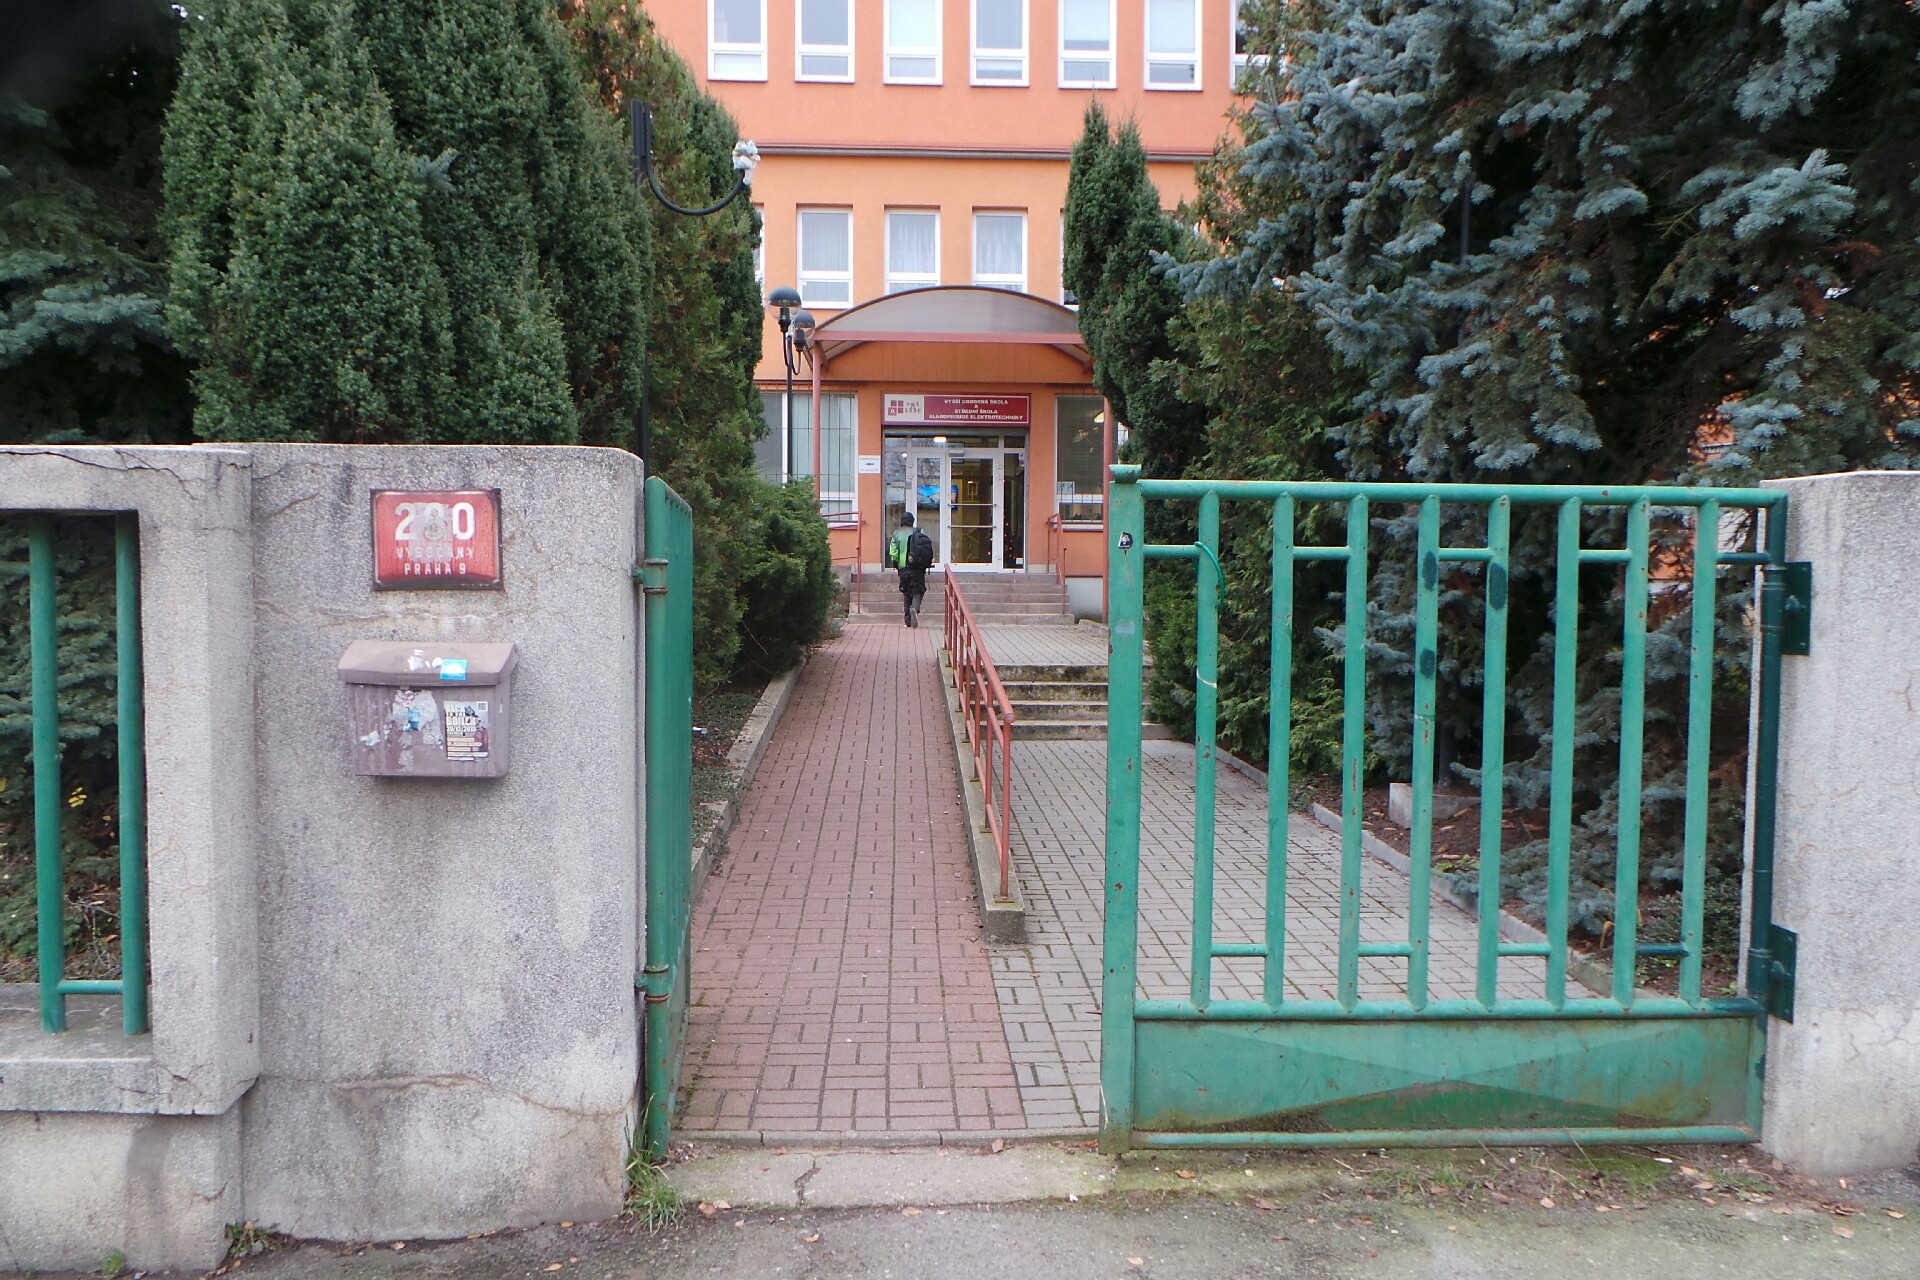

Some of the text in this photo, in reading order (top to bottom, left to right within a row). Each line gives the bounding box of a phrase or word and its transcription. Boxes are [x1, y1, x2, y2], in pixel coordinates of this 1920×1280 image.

[394, 502, 475, 540] 280
[404, 563, 466, 575] PRAHA 9
